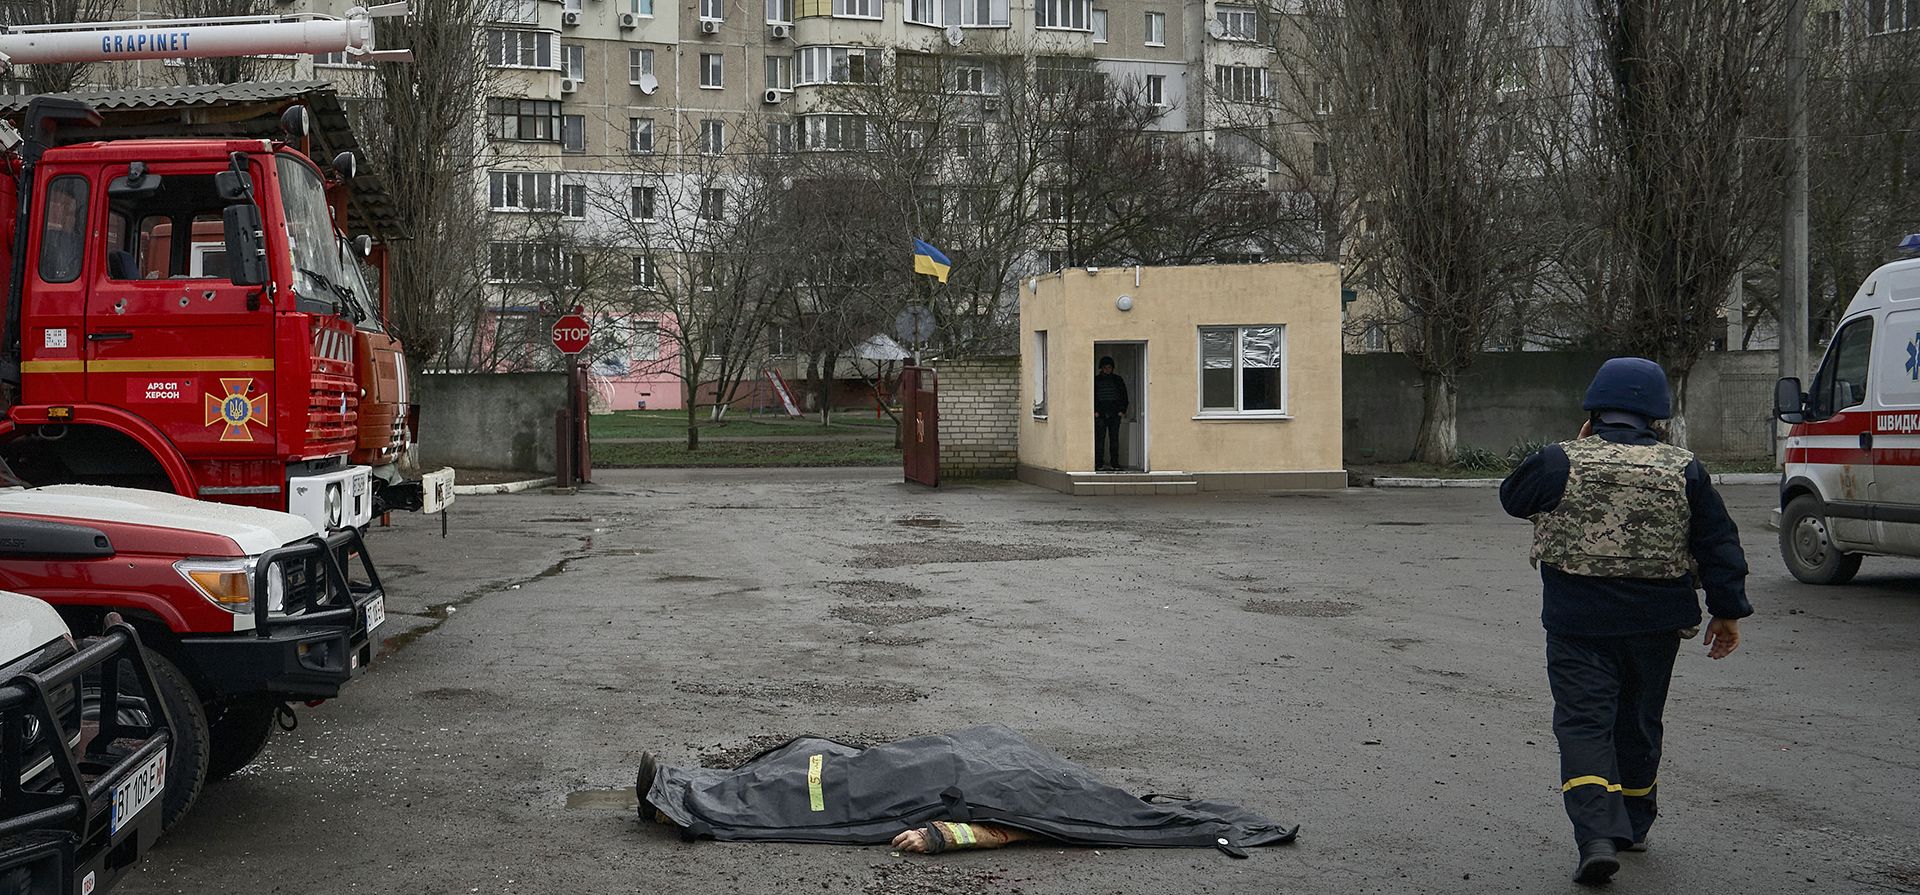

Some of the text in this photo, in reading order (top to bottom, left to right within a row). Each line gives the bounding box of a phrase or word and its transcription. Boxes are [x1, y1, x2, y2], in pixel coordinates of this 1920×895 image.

[102, 32, 189, 52] GRAPINET
[553, 328, 590, 341] STOP
[147, 382, 177, 390] АРЗ СП
[145, 391, 180, 399] ХЕРСОН
[118, 762, 156, 823] BT 109 E
